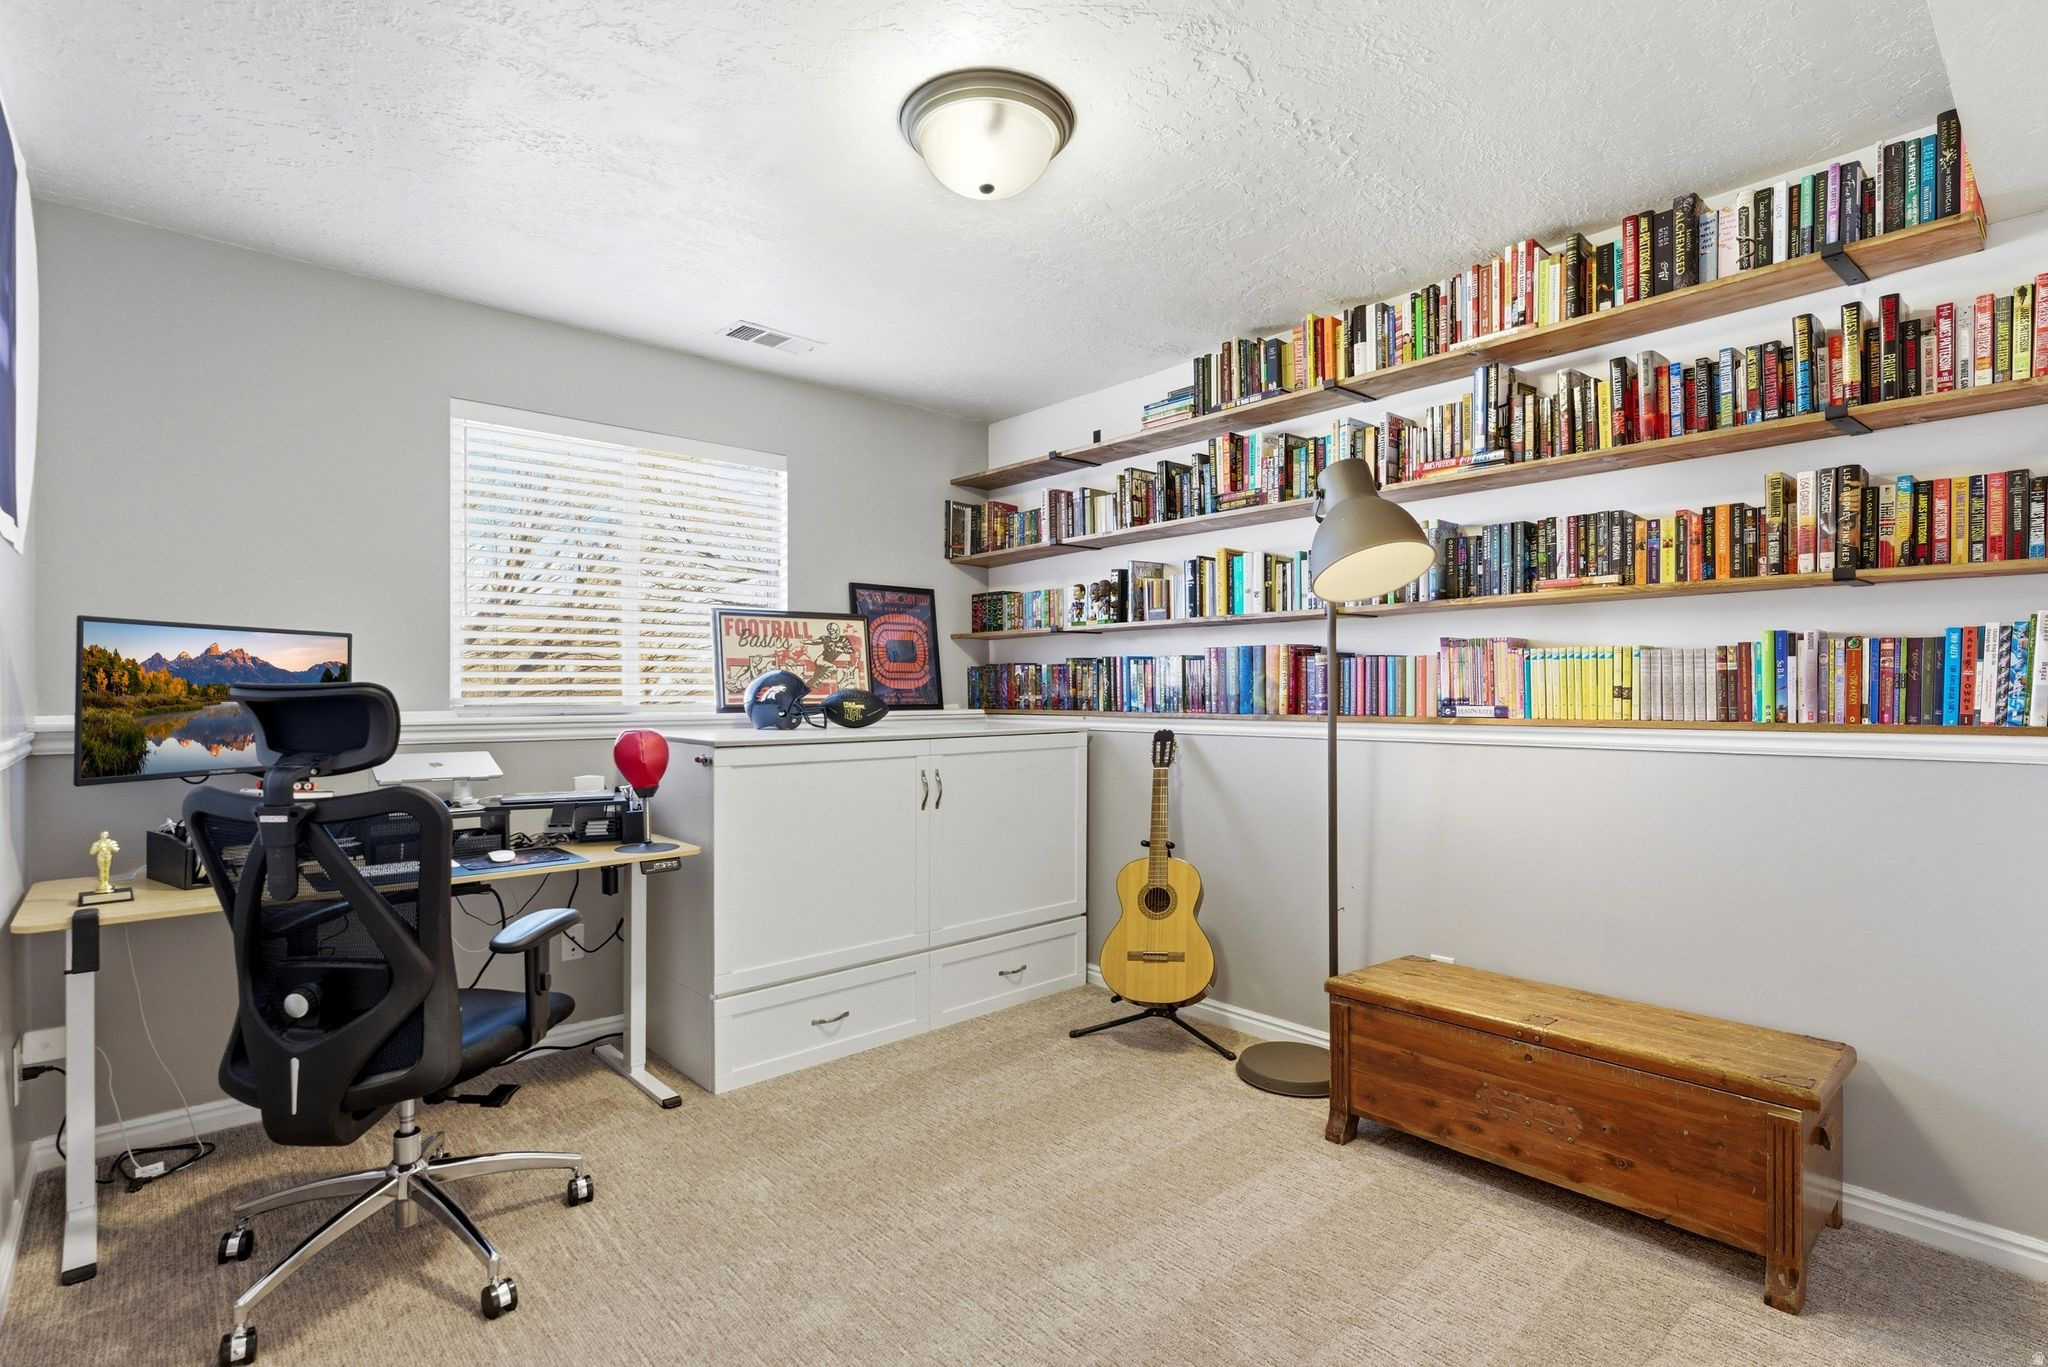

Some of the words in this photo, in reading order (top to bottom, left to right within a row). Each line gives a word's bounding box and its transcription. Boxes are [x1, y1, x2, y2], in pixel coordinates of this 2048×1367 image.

[1639, 232, 1650, 271] PATTERSON
[1675, 211, 1685, 275] ALCHEMISED
[1843, 307, 1857, 332] JAMES
[1939, 318, 1951, 337] JAMES
[1977, 312, 1991, 329] JAMES
[2020, 306, 2029, 324] JAMES
[1998, 322, 2009, 340] JAMES
[2020, 325, 2029, 352] PATTERSON
[1939, 338, 1951, 371] PATTERSON
[1977, 329, 1991, 359] PATTERSON
[1998, 341, 2009, 372] PATTERSON
[1295, 340, 1303, 381] BASKETBALL
[1765, 353, 1777, 374] JAMES
[1871, 358, 1879, 387] PATTERSON
[1884, 353, 1896, 383] PRIVATE
[1697, 367, 1707, 385] JAMES
[1697, 386, 1707, 417] PATTERSON
[1765, 374, 1777, 409] PATTERSON
[1613, 410, 1624, 435] GONE
[1770, 478, 1781, 491] LISA
[1800, 477, 1809, 489] LISA
[1822, 472, 1832, 486] LISA
[1771, 492, 1781, 518] GARDNER
[1800, 490, 1809, 516] GARDNER
[1822, 487, 1831, 514] GARDNER
[1897, 491, 1910, 507] JAMES
[1918, 494, 1927, 512] JAMES
[1935, 498, 1948, 513] JAMES
[1972, 497, 1984, 513] JAMES
[1991, 488, 2002, 505] JAMES
[1880, 501, 1895, 536] THRILLER
[1991, 506, 2002, 536] PATTERSON
[2031, 502, 2045, 517] JAMES
[1918, 513, 1927, 544] PATTERSON
[1972, 514, 1984, 541] PATTERSON
[724, 618, 813, 640] FOOTBALL
[738, 628, 792, 649] Basics
